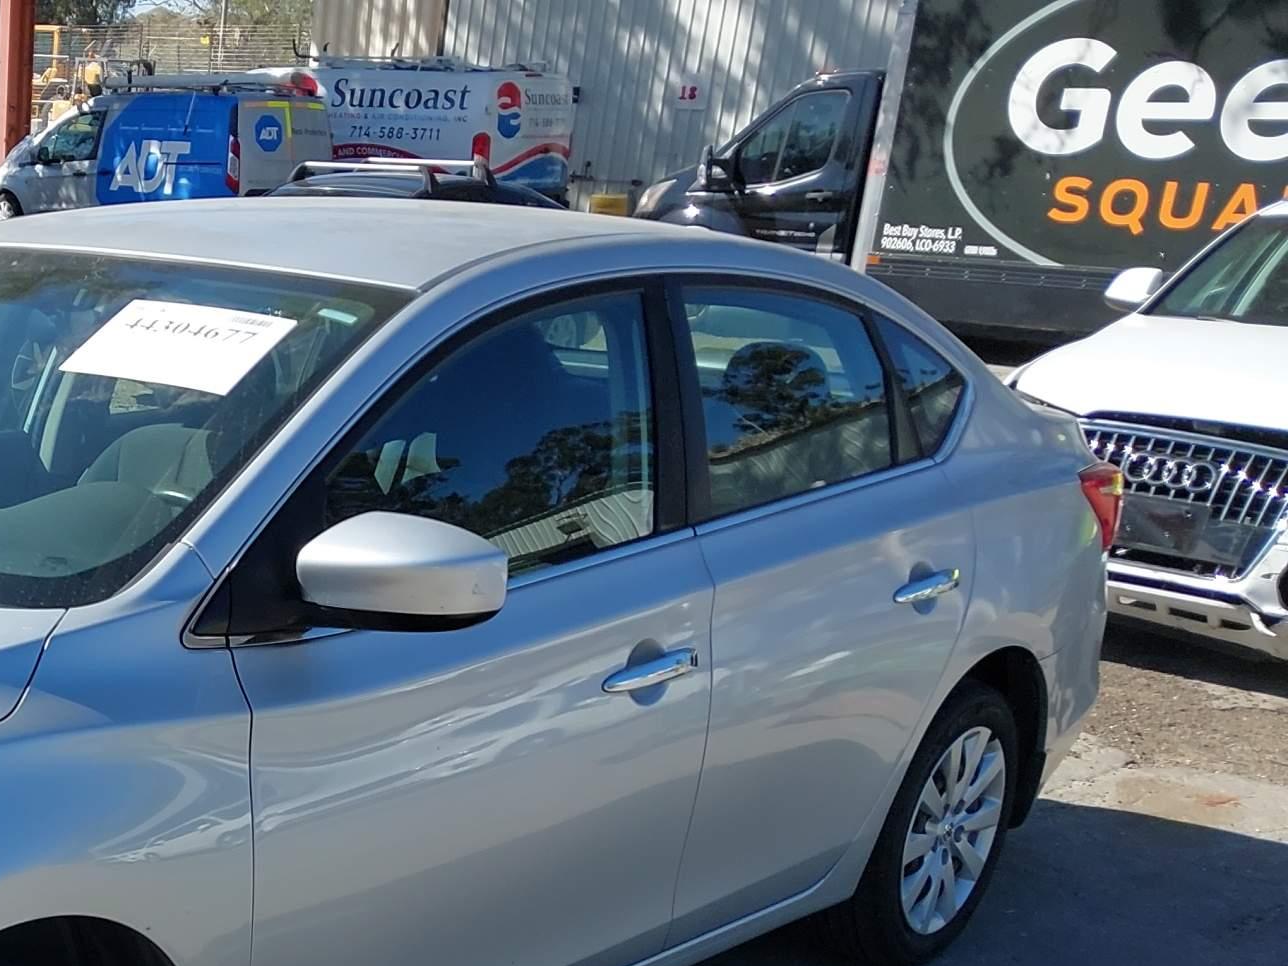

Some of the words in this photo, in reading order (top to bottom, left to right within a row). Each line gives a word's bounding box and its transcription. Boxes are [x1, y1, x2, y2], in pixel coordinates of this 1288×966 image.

[331, 78, 471, 111] Suncoast
[678, 86, 697, 100] 18
[259, 126, 279, 140] ADT
[349, 125, 441, 141] 714-588-3711
[109, 139, 192, 195] ADT
[1047, 176, 1288, 235] SQUA
[883, 223, 902, 237] Best
[901, 224, 918, 240] Buy
[918, 225, 946, 240] Stores,
[125, 318, 258, 344] 44304677
